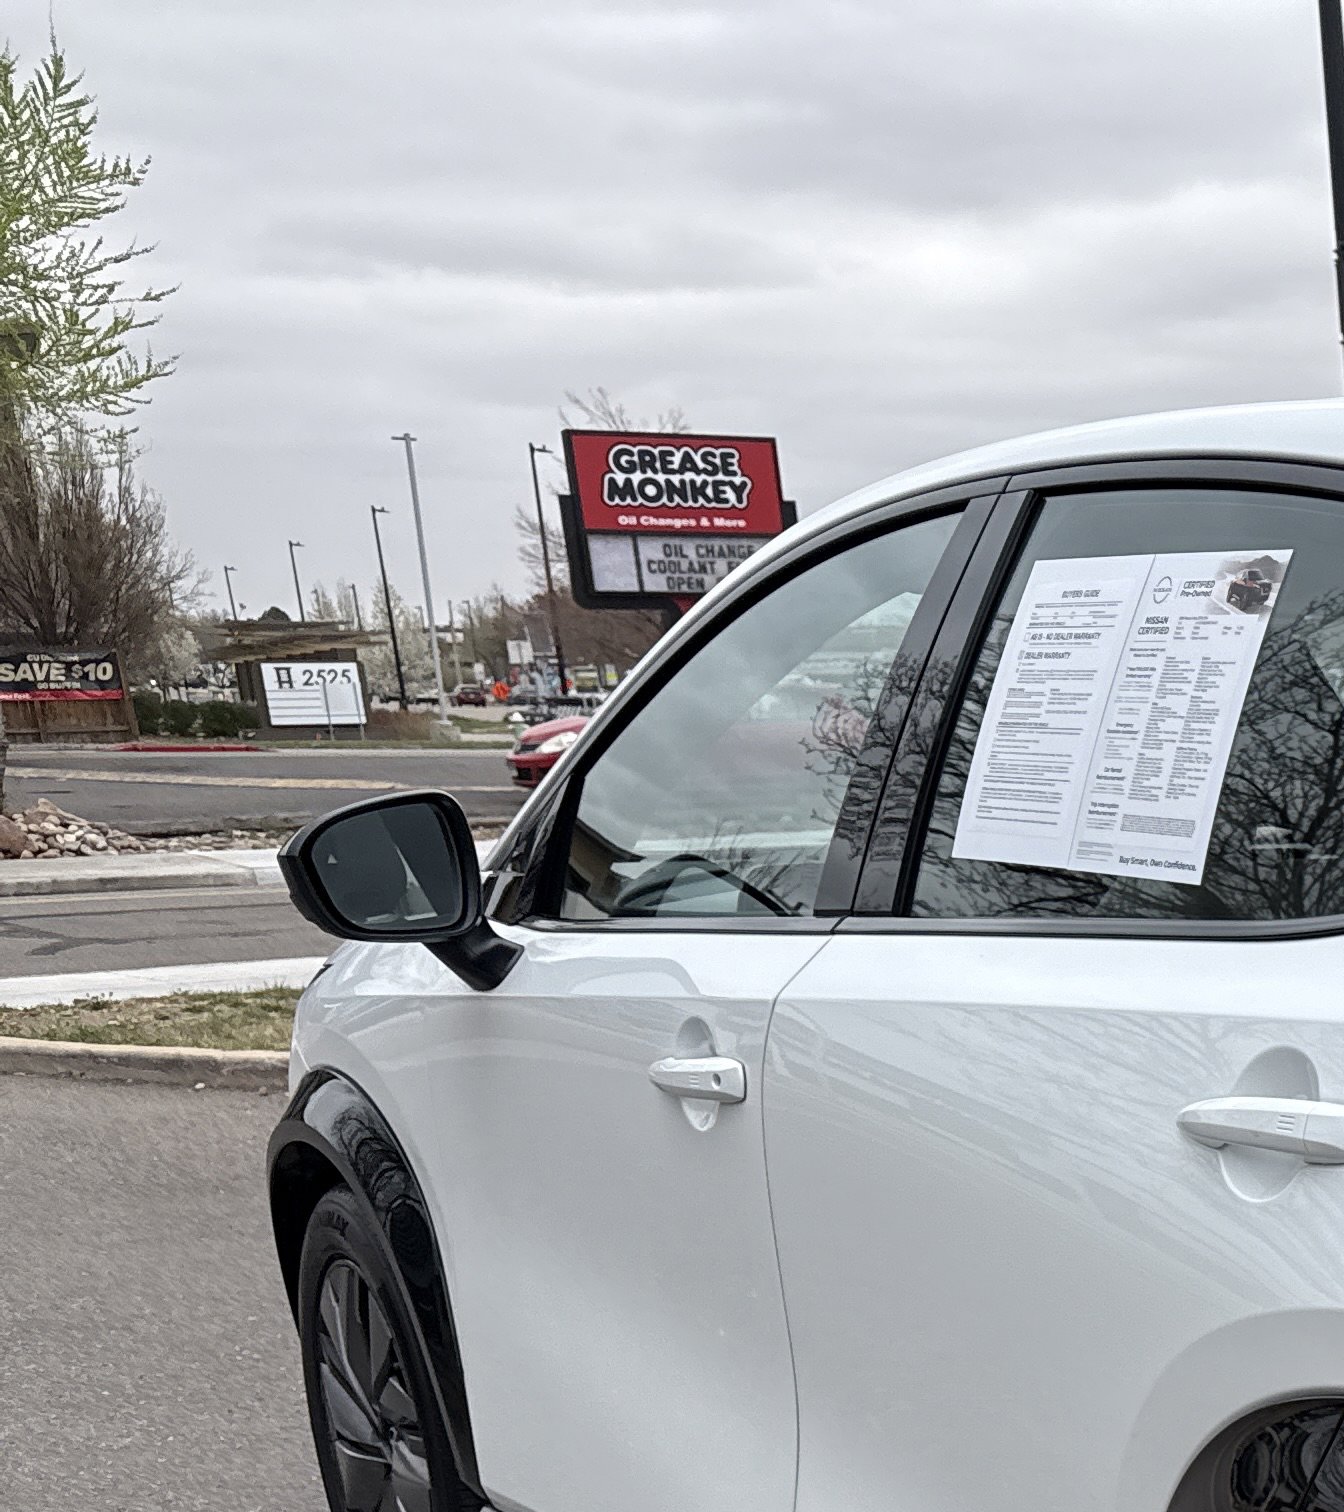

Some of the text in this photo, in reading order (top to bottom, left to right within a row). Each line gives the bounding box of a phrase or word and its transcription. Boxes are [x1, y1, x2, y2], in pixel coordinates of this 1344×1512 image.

[611, 447, 739, 478] GREASE
[605, 477, 750, 505] MONKEY
[617, 516, 637, 527] Oil
[639, 515, 697, 529] Changes
[713, 517, 748, 528] More
[663, 543, 689, 558] OIL
[647, 560, 716, 575] COOLANT
[666, 576, 706, 591] OPEN
[1183, 580, 1215, 589] CERTIFIED
[1145, 616, 1169, 625] NISSAN
[1138, 627, 1169, 635] CERTIFIED
[0, 661, 114, 682] SAVE $10
